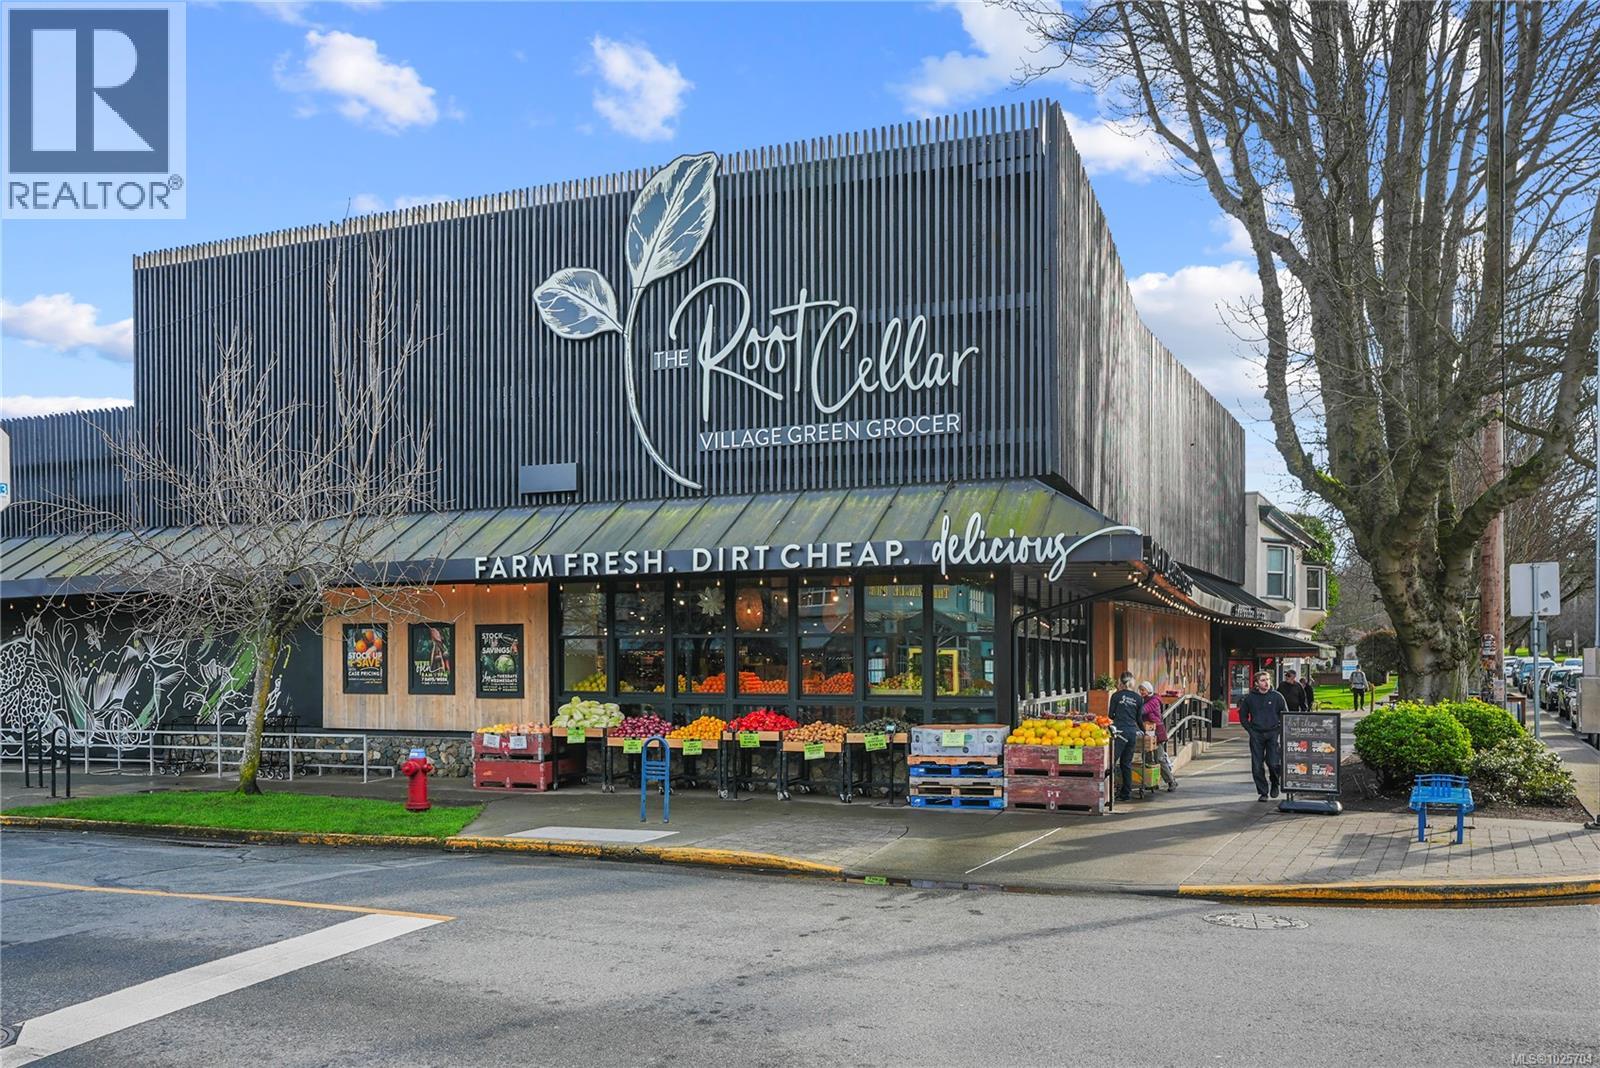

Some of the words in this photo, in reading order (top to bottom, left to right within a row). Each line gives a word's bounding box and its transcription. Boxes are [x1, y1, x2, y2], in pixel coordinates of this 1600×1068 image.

[653, 349, 690, 368] THE
[669, 277, 840, 422] Root
[811, 306, 980, 413] Cellar
[699, 427, 782, 450] VILLAGE
[787, 421, 860, 444] GREEN
[866, 413, 961, 436] GROCER
[474, 555, 553, 579] FARM
[563, 549, 675, 576] FRESH.
[692, 545, 770, 572] DIRT
[780, 540, 910, 568] CHEAP.
[931, 511, 1142, 582] delicious
[481, 632, 504, 640] STOCK
[356, 659, 381, 667] SAVE
[1164, 638, 1207, 690] VEGGIES
